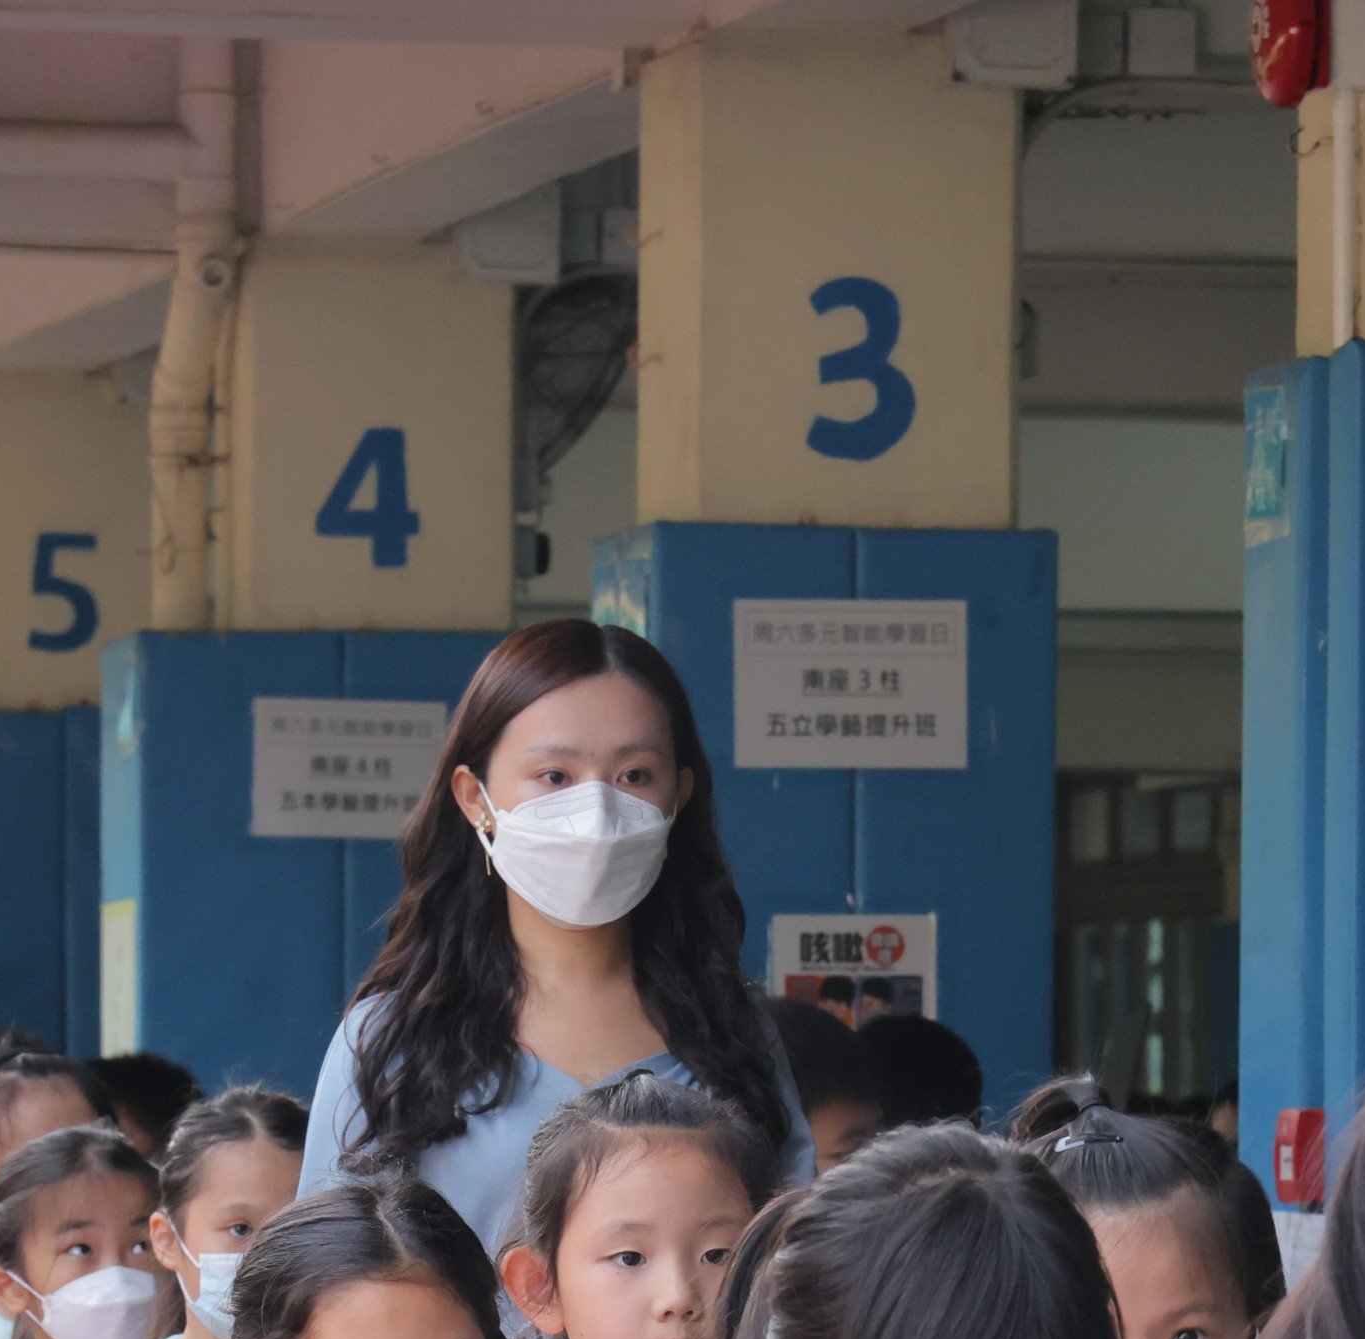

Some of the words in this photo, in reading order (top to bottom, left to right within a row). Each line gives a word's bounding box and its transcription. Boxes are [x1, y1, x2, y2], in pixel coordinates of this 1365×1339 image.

[805, 276, 916, 462] 3
[315, 427, 421, 569] 4
[28, 532, 100, 653] 5
[859, 669, 872, 691] 3
